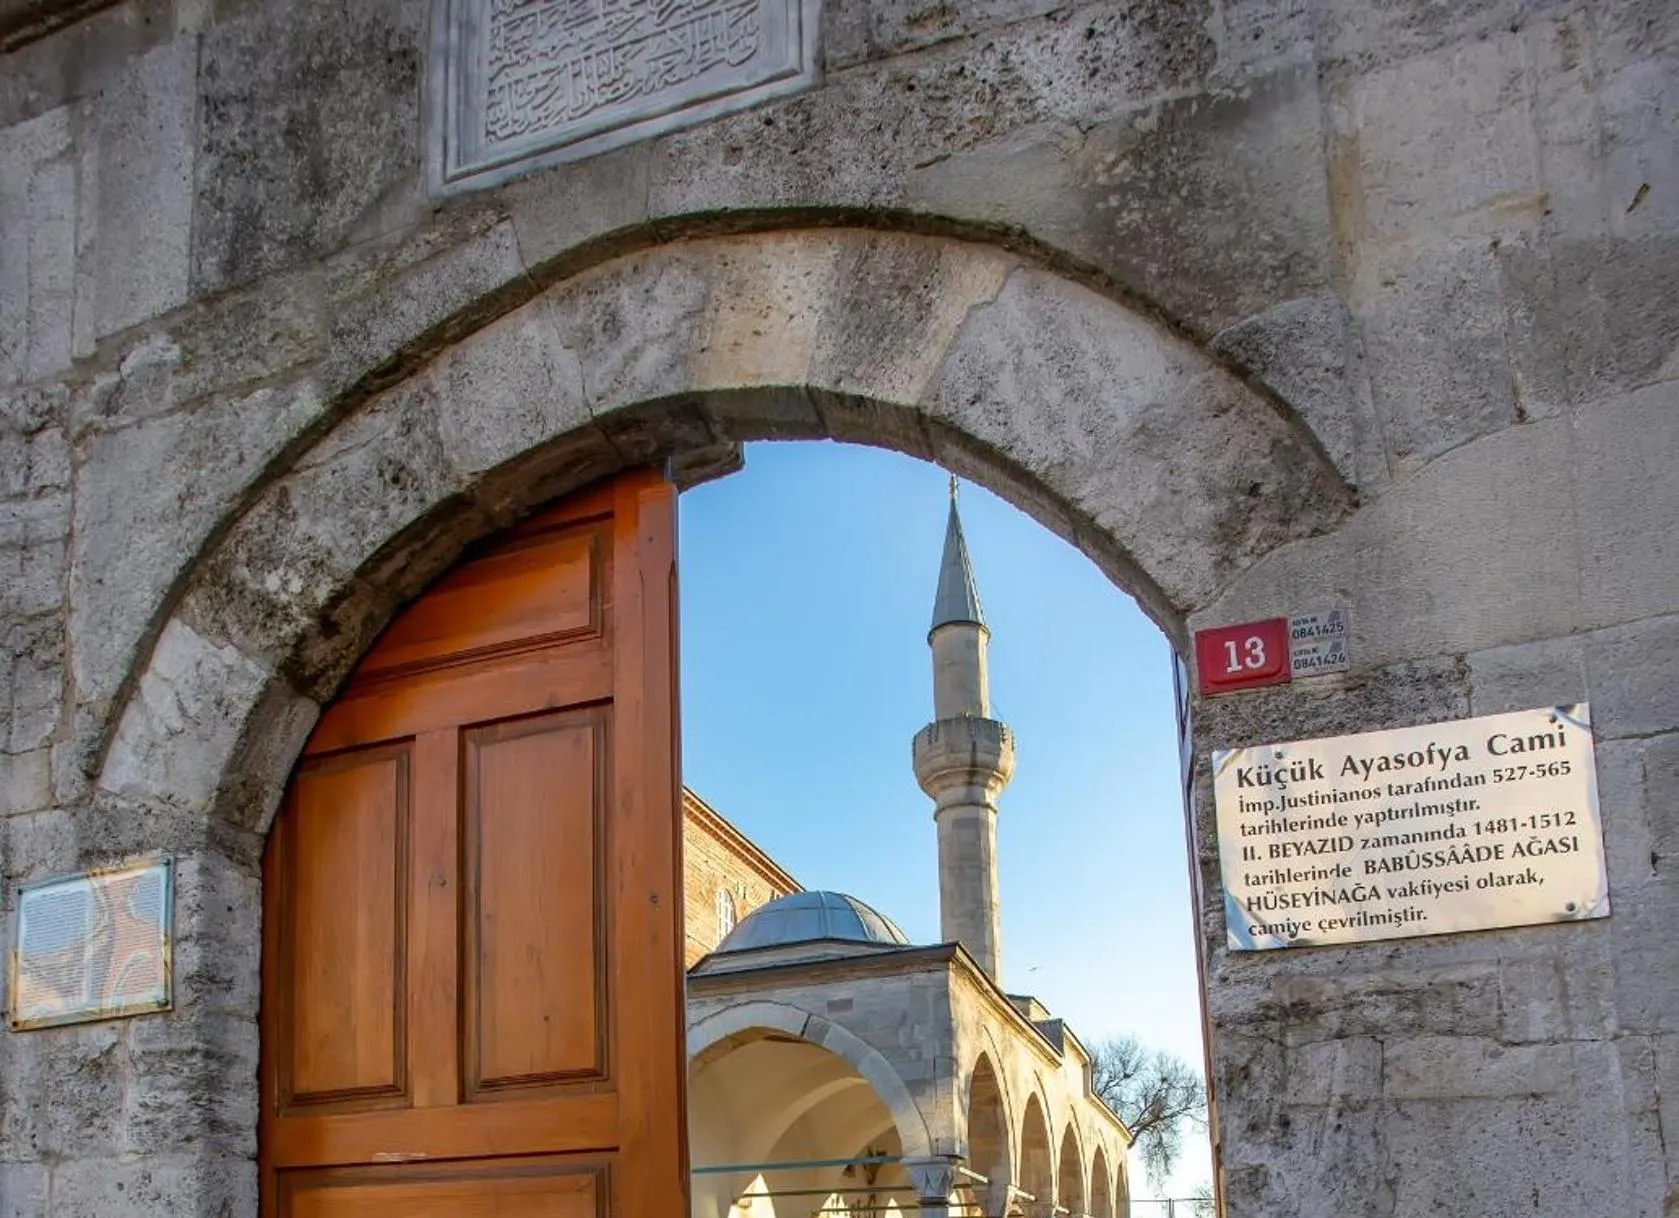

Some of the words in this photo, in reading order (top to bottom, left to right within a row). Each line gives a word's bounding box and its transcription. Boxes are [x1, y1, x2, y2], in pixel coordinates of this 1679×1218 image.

[1224, 636, 1266, 673] 13
[1237, 758, 1324, 789] Küçük
[1341, 742, 1470, 781] Ayasofya
[1487, 724, 1566, 756] Cami
[1388, 773, 1486, 797] tarafından
[1493, 761, 1571, 783] 527-565
[1240, 813, 1348, 837] tarihlerinde
[1354, 798, 1481, 829] yaptırılmıştır.
[1243, 846, 1261, 861] II.
[1269, 836, 1354, 859] BEYAZID
[1360, 824, 1466, 850] zamanında
[1474, 811, 1576, 835] 1481-1512
[1245, 863, 1352, 886] tarihlerinde
[1512, 836, 1578, 858] AĞASI
[1247, 883, 1381, 912] HÜSEYİNAĞA
[1387, 875, 1469, 899] vakfiyesi
[1477, 868, 1545, 889] olarak,
[1248, 917, 1311, 938] camiye
[1318, 905, 1428, 933] çevrilmiştir.
